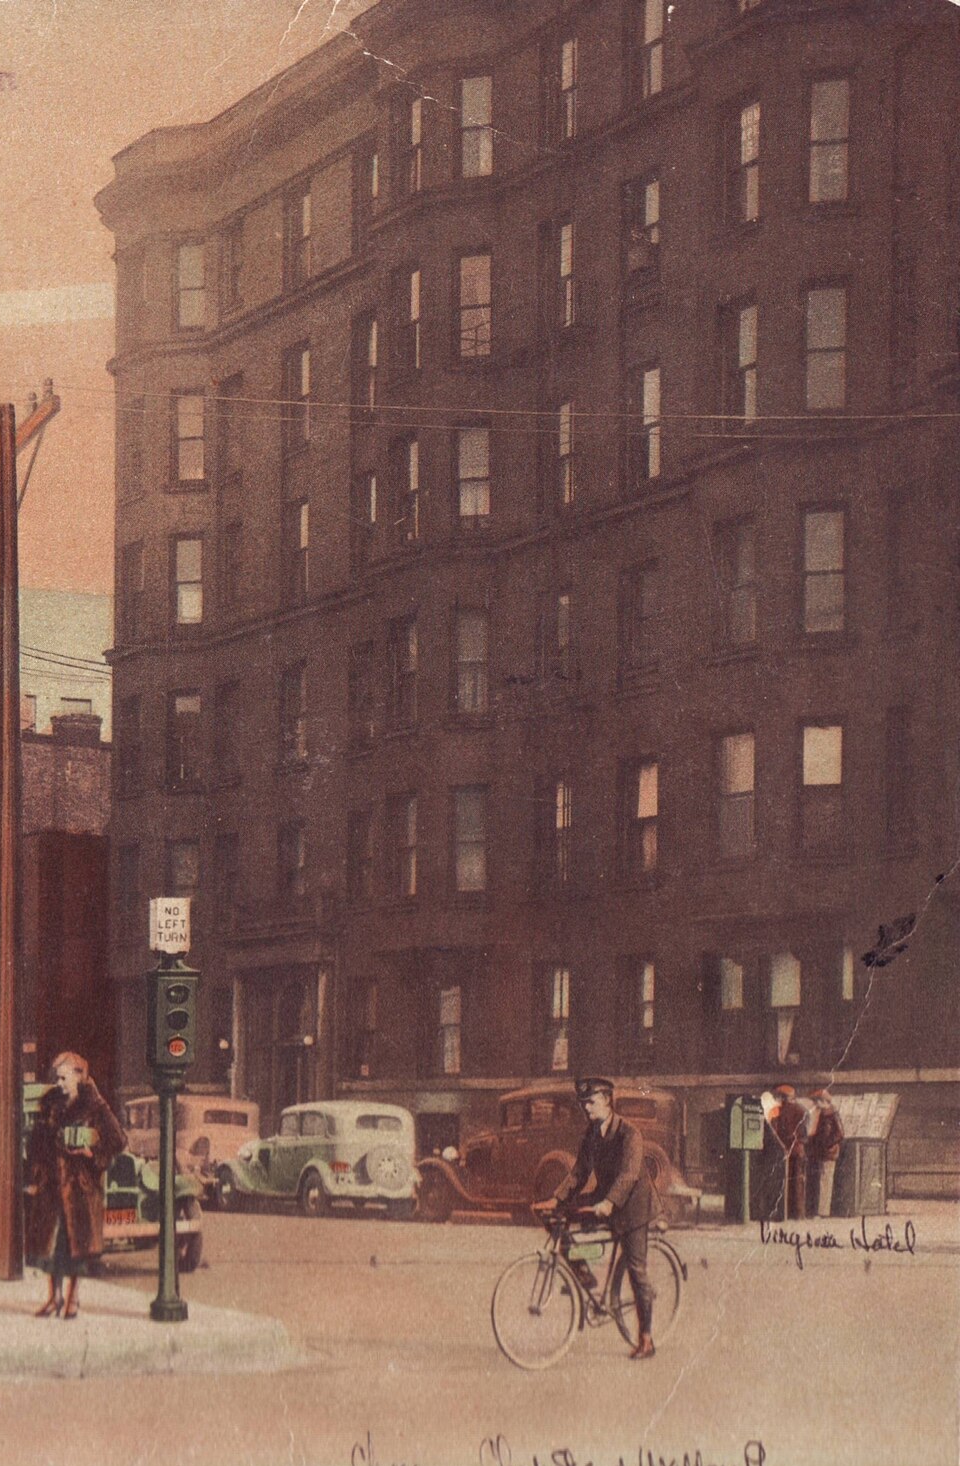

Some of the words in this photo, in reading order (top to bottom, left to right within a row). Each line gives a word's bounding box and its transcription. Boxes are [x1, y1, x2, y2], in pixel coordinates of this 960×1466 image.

[164, 906, 180, 917] NO
[158, 919, 186, 930] LEFT
[157, 932, 187, 943] TURN
[850, 1215, 916, 1255] Hotel
